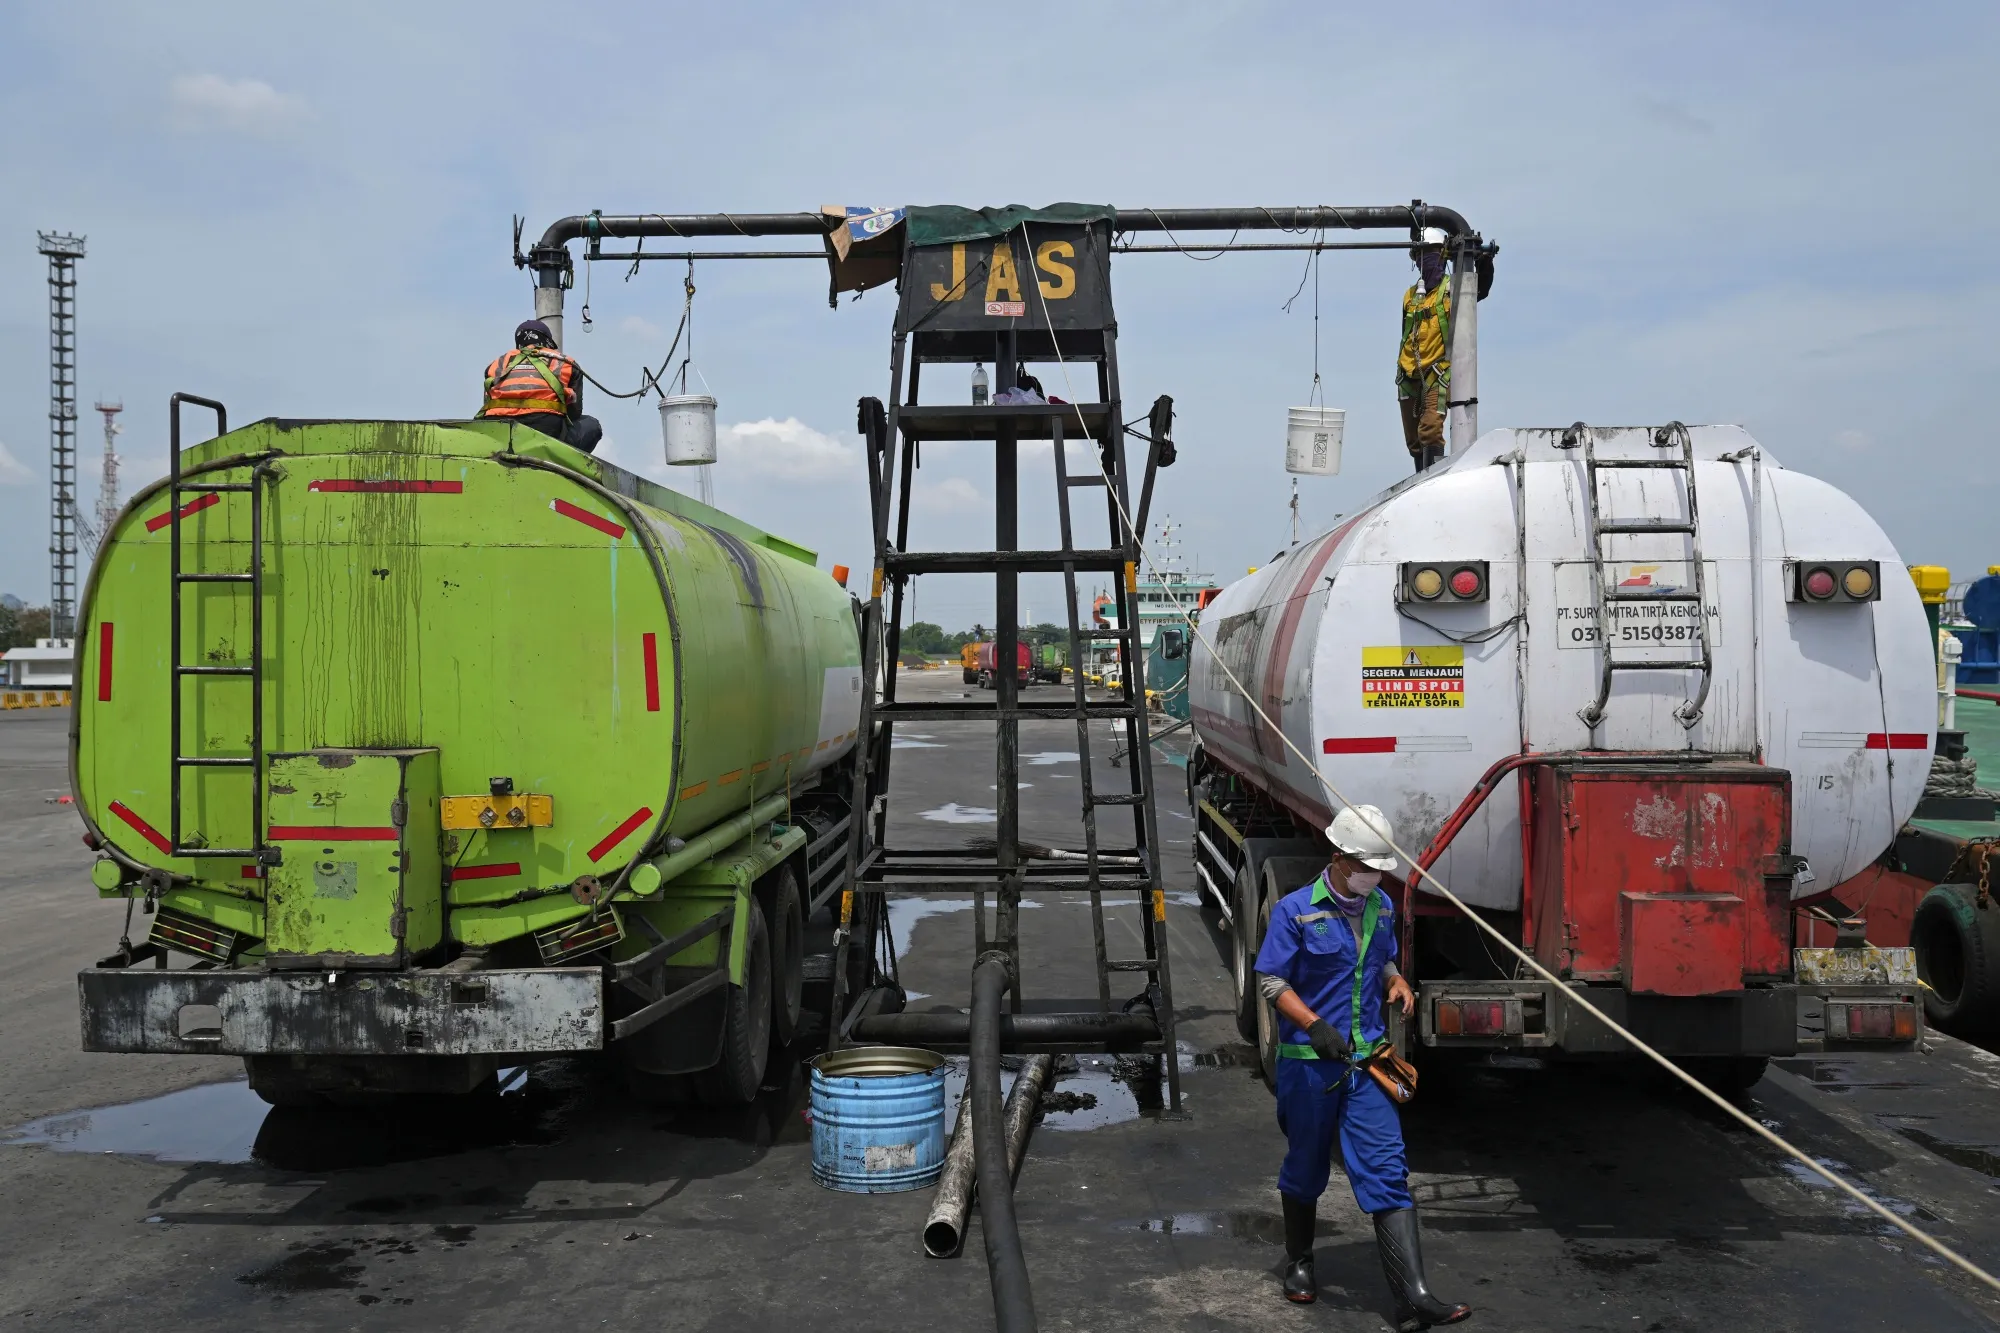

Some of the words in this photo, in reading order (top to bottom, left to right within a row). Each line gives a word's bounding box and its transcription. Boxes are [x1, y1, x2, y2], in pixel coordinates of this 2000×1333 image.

[930, 241, 1076, 302] JAS
[1557, 607, 1572, 620] PT.
[1573, 606, 1603, 619] SURY
[1608, 606, 1640, 618] MITRA
[1641, 606, 1669, 618] TIRTA
[1571, 627, 1602, 642] 031
[1622, 625, 1704, 641] 51503872
[1362, 669, 1405, 677] SEGERA
[1409, 668, 1463, 677] MENJAUH
[1365, 682, 1414, 691] BLIND
[1418, 681, 1460, 691] SPOT
[1412, 692, 1447, 700] TIDAK
[1425, 699, 1460, 707] SOPIR
[1818, 775, 1834, 790] 15
